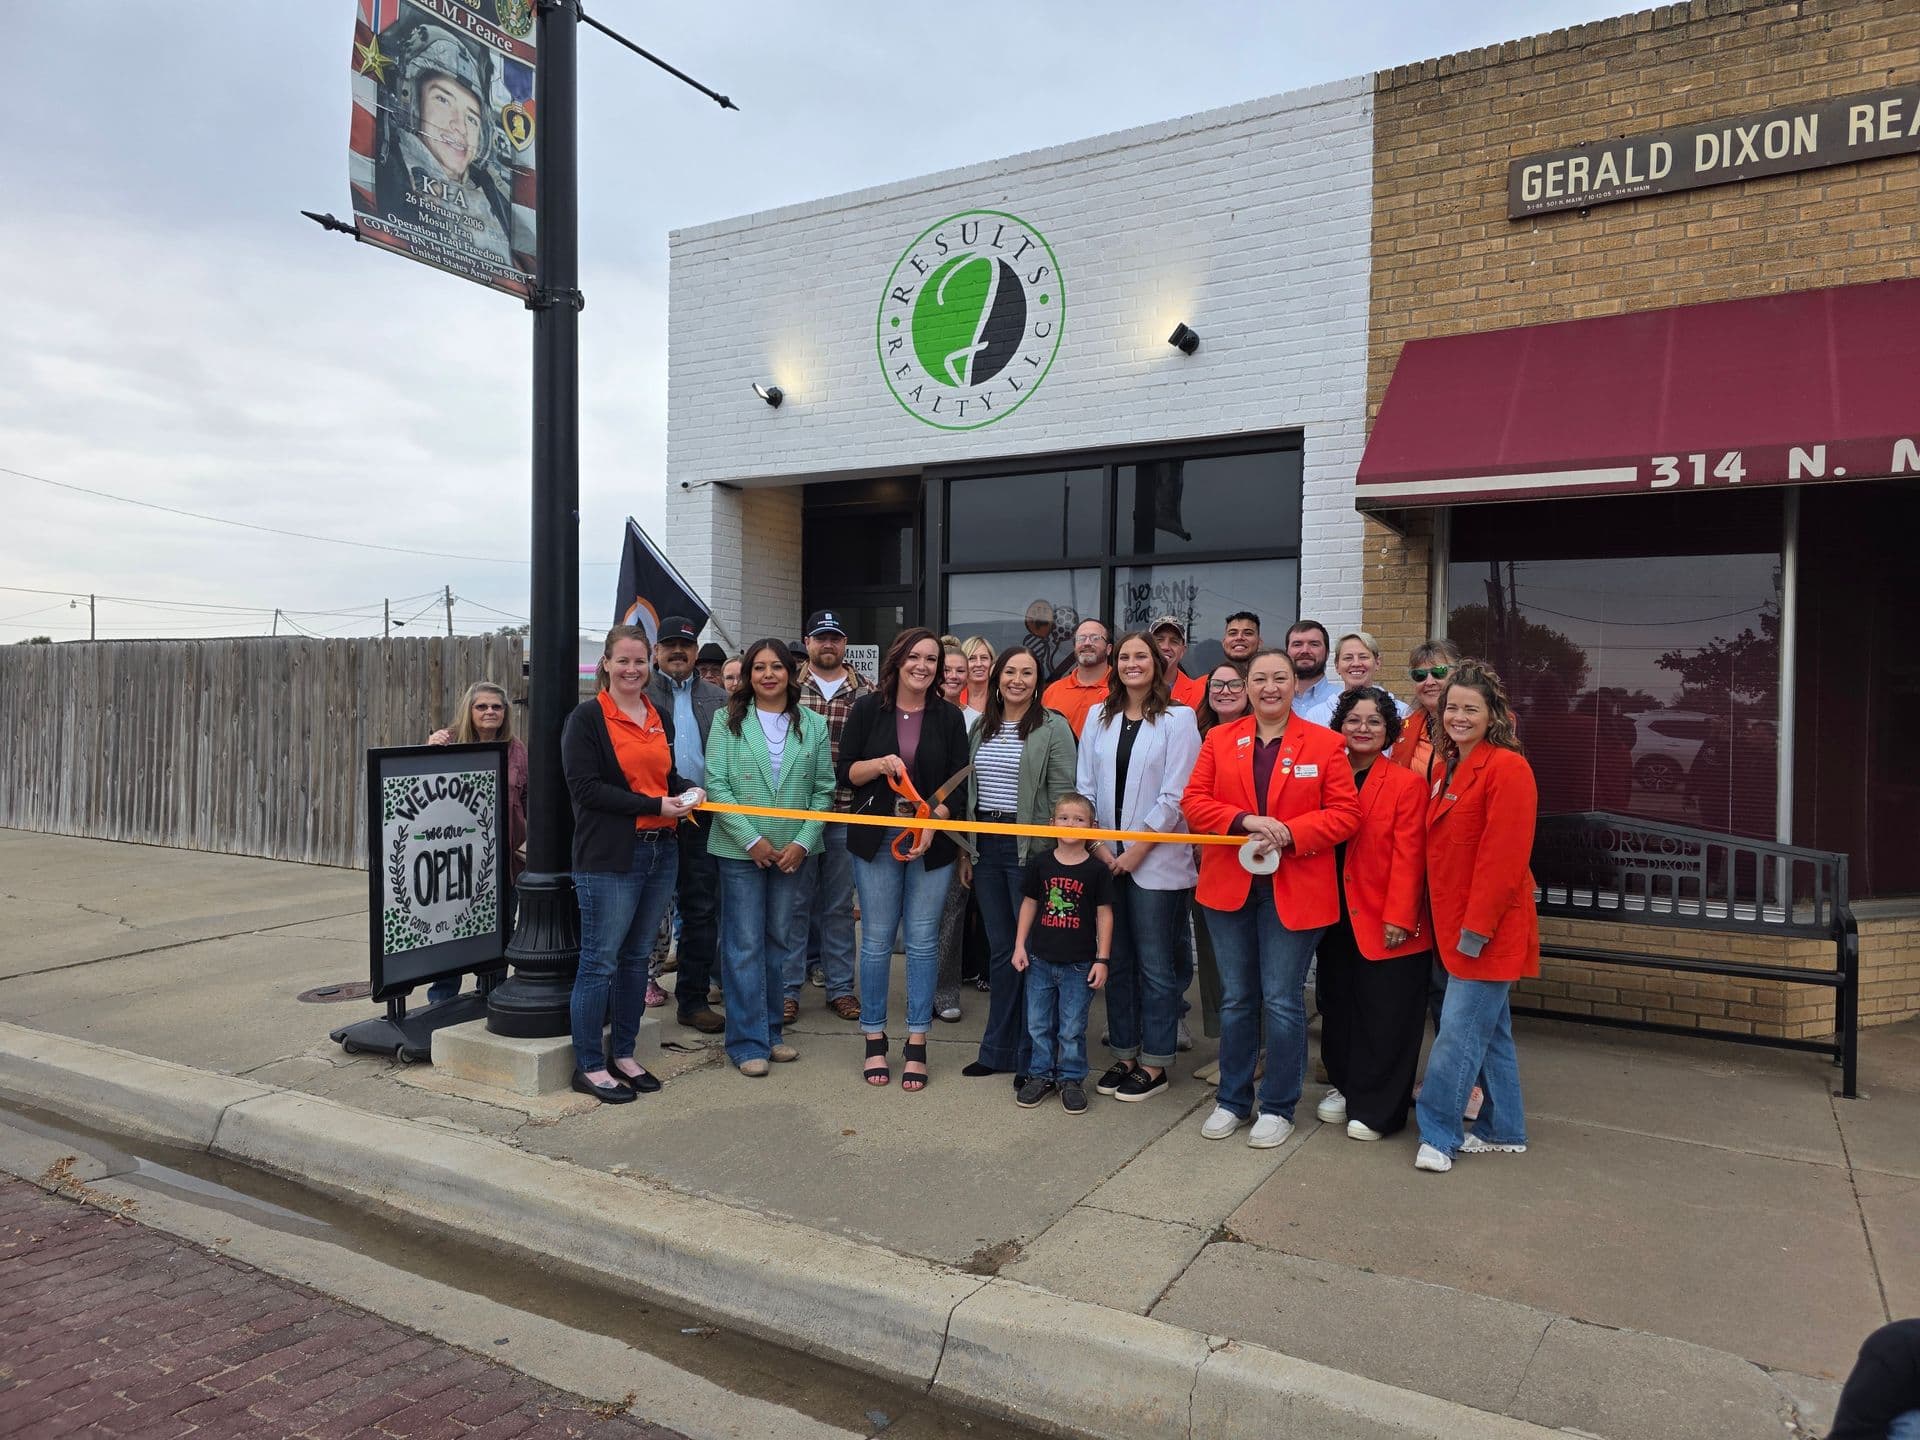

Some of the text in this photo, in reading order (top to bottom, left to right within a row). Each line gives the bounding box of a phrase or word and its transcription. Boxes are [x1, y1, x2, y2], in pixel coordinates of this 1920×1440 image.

[441, 1, 462, 25] M.
[466, 13, 513, 53] Pearce
[1522, 141, 1674, 202] GERALD
[1695, 113, 1819, 173] DIXON
[405, 192, 485, 231] 26 February 2006
[1615, 188, 1626, 196] 314
[387, 213, 505, 264] Operation Iraqi Freedom
[418, 211, 474, 242] Mosul, Iraq
[363, 217, 381, 230] CO
[394, 230, 410, 242] 2nd
[410, 234, 429, 249] BN,
[430, 242, 442, 253] 1st
[442, 244, 480, 269] Infantry,
[480, 261, 503, 276] 172nd
[503, 270, 528, 285] SBCT
[410, 245, 494, 284] United States Army
[891, 220, 1050, 306] RESULTS
[887, 321, 1053, 417] REALTY LLC
[1650, 451, 1746, 489] 314
[1788, 445, 1847, 480] N.
[844, 660, 873, 671] ERC
[394, 775, 488, 823] WELCOME
[413, 843, 474, 907] OPEN
[1050, 876, 1085, 895] STEAL
[1648, 859, 1695, 872] DIXON
[409, 907, 470, 934] come on in!
[1041, 914, 1081, 929] HEARTS
